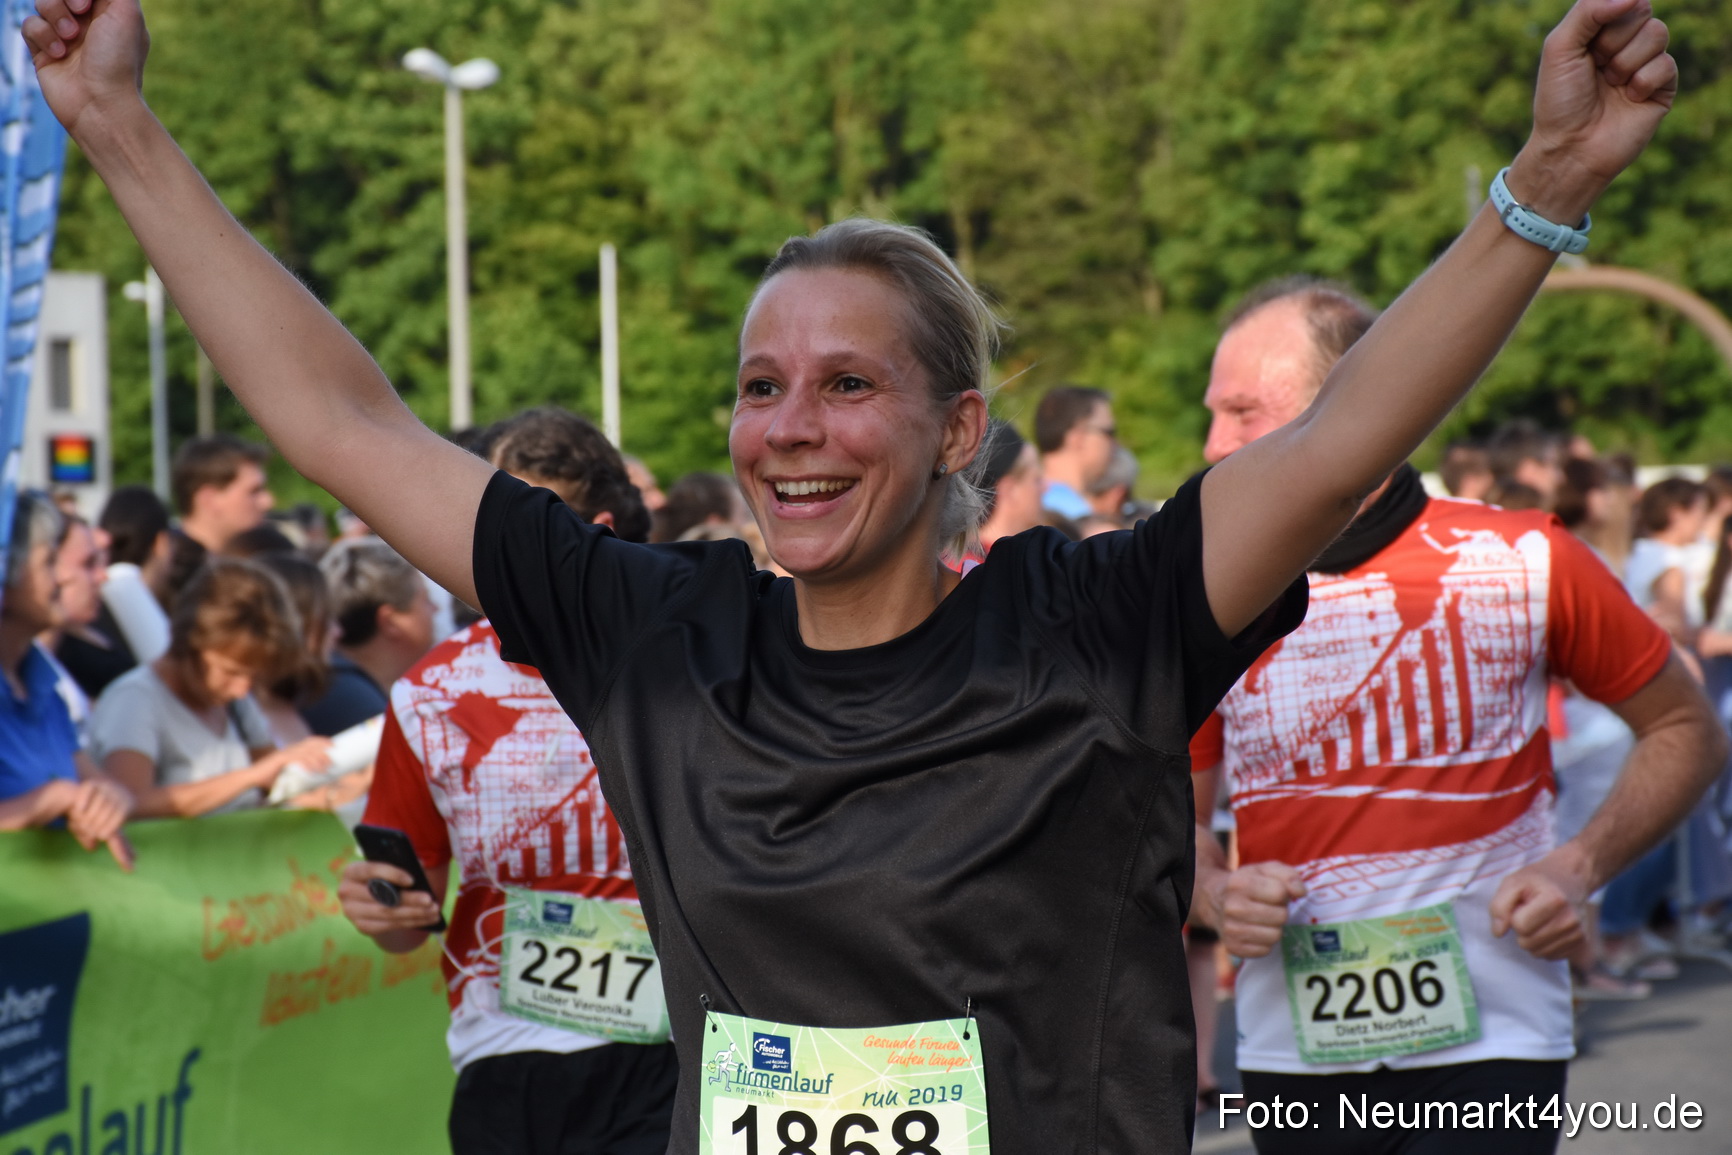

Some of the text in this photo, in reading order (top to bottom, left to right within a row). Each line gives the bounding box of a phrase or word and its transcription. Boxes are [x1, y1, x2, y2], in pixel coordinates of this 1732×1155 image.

[520, 940, 654, 1002] 2217
[1305, 959, 1445, 1022] 2206
[1335, 1014, 1428, 1037] Dietz Norbert
[758, 1042, 786, 1056] Fischer
[863, 1034, 961, 1051] Gesunde Firmen
[887, 1050, 974, 1073] laufen länger!
[736, 1062, 835, 1095] firmenlauf
[735, 1086, 776, 1099] neumarkt
[862, 1084, 964, 1108] run 2019
[732, 1104, 940, 1155] 1868
